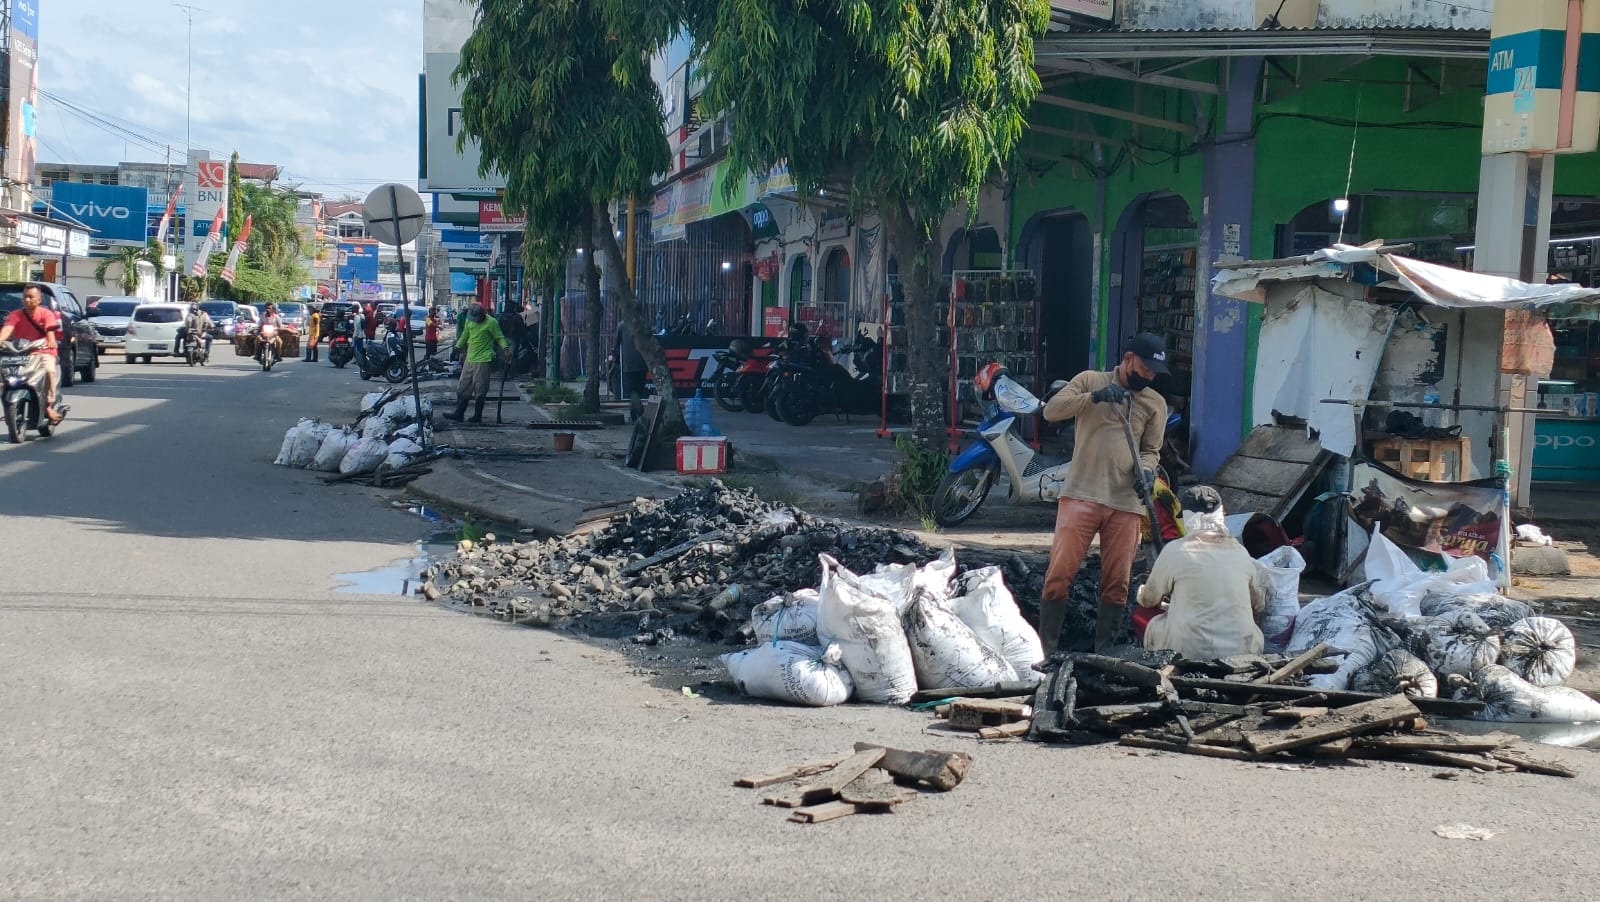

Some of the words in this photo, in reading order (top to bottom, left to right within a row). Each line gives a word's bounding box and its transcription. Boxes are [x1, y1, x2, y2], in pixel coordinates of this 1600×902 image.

[1490, 48, 1514, 73] ATM
[198, 190, 222, 202] BNI
[70, 200, 130, 219] vivo
[483, 203, 502, 212] KEM
[1535, 434, 1596, 450] ppo
